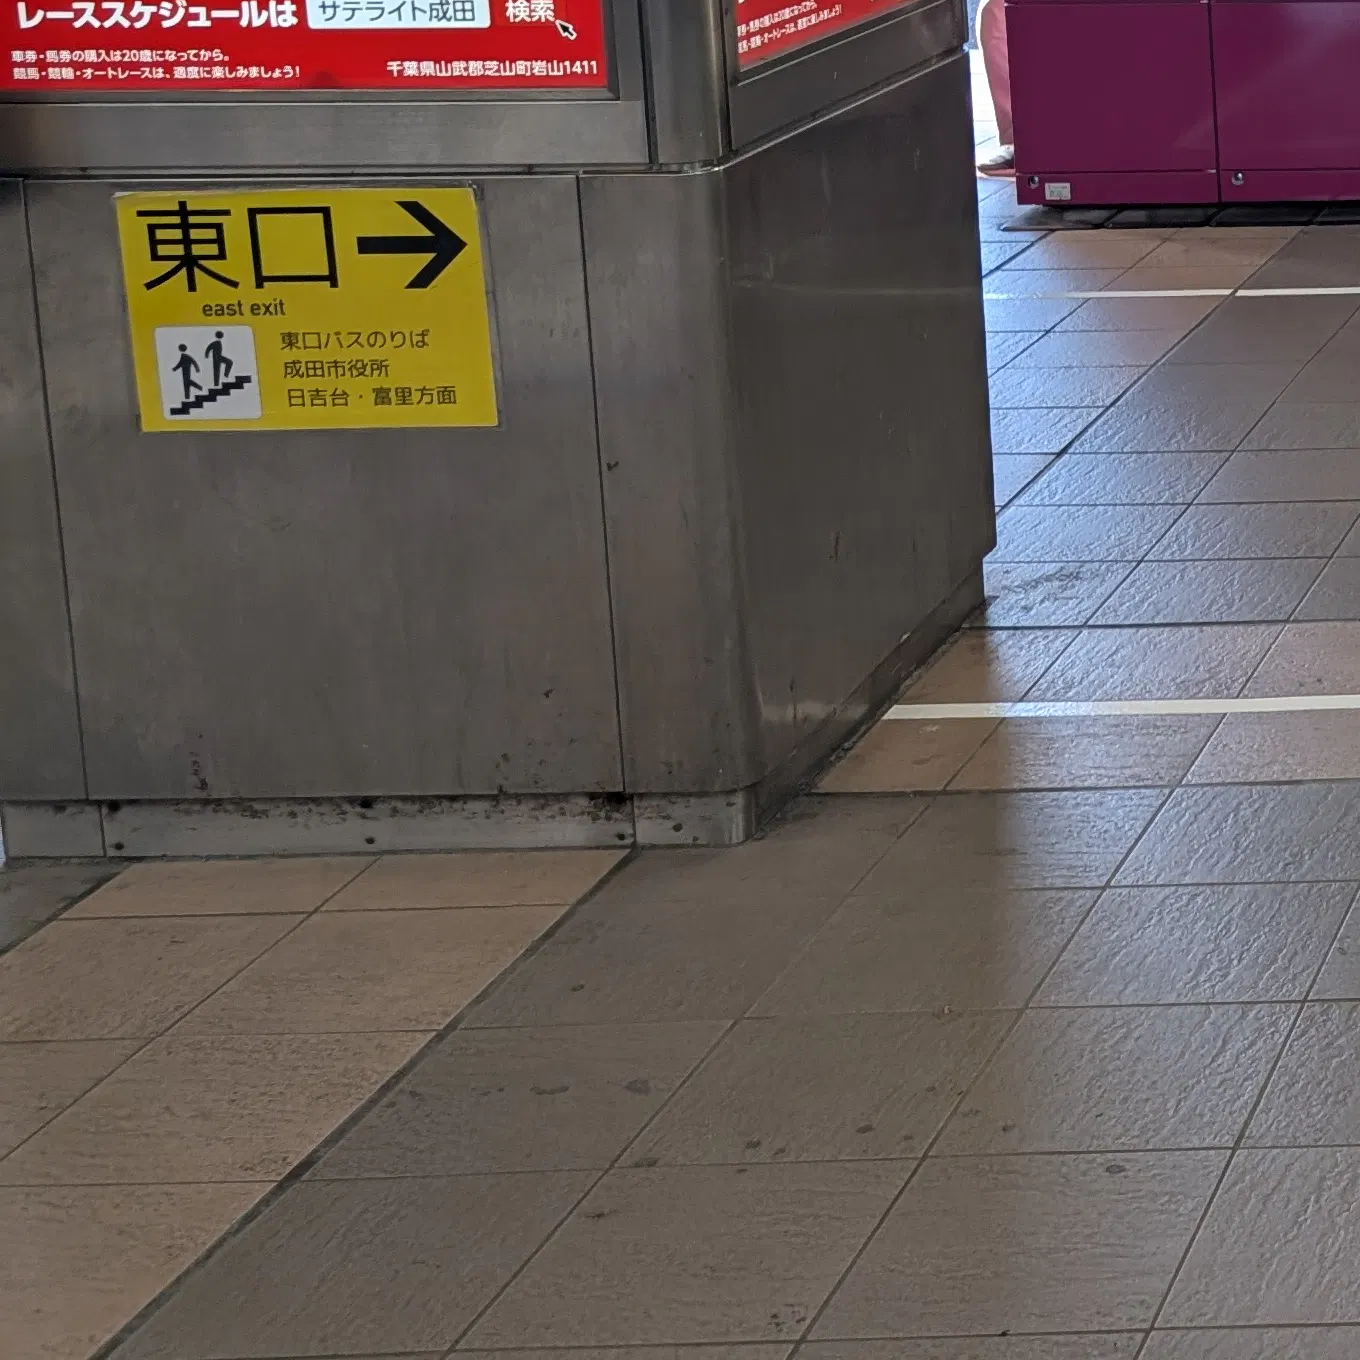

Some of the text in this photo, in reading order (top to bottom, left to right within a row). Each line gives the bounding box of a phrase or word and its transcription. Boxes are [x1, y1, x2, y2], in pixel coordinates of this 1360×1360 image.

[17, 0, 299, 30] レーススケジュールは
[317, 0, 476, 24] サテライト成田
[386, 60, 598, 77] 千葉県山武郡芝山町岩山1411
[136, 200, 339, 293] 東口
[202, 296, 287, 318] east exit
[280, 329, 431, 352] 東口バスのりば
[283, 359, 391, 380] 成田市役所
[286, 385, 459, 408] 日吉台・富里方面
